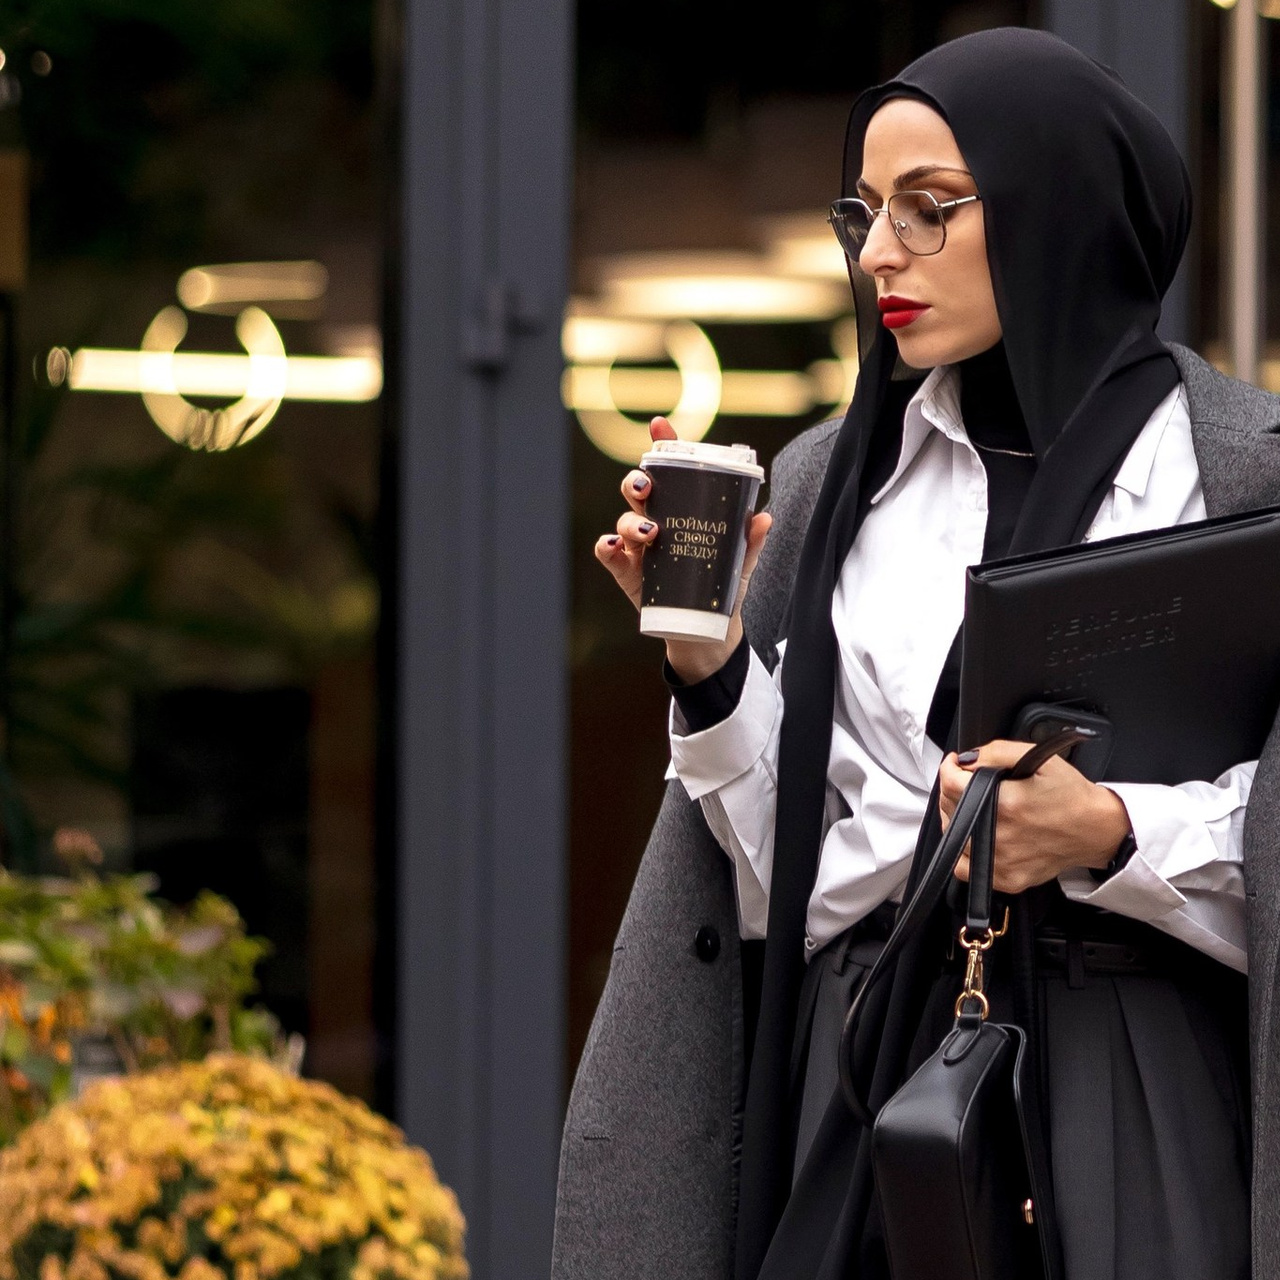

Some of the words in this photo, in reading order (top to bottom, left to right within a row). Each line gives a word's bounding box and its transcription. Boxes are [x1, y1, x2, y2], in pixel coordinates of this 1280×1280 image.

[666, 517, 727, 535] ПОЙМАЙ
[674, 531, 716, 546] СВОЮ
[1045, 595, 1183, 641] PERFUME
[1044, 626, 1177, 668] STARTER
